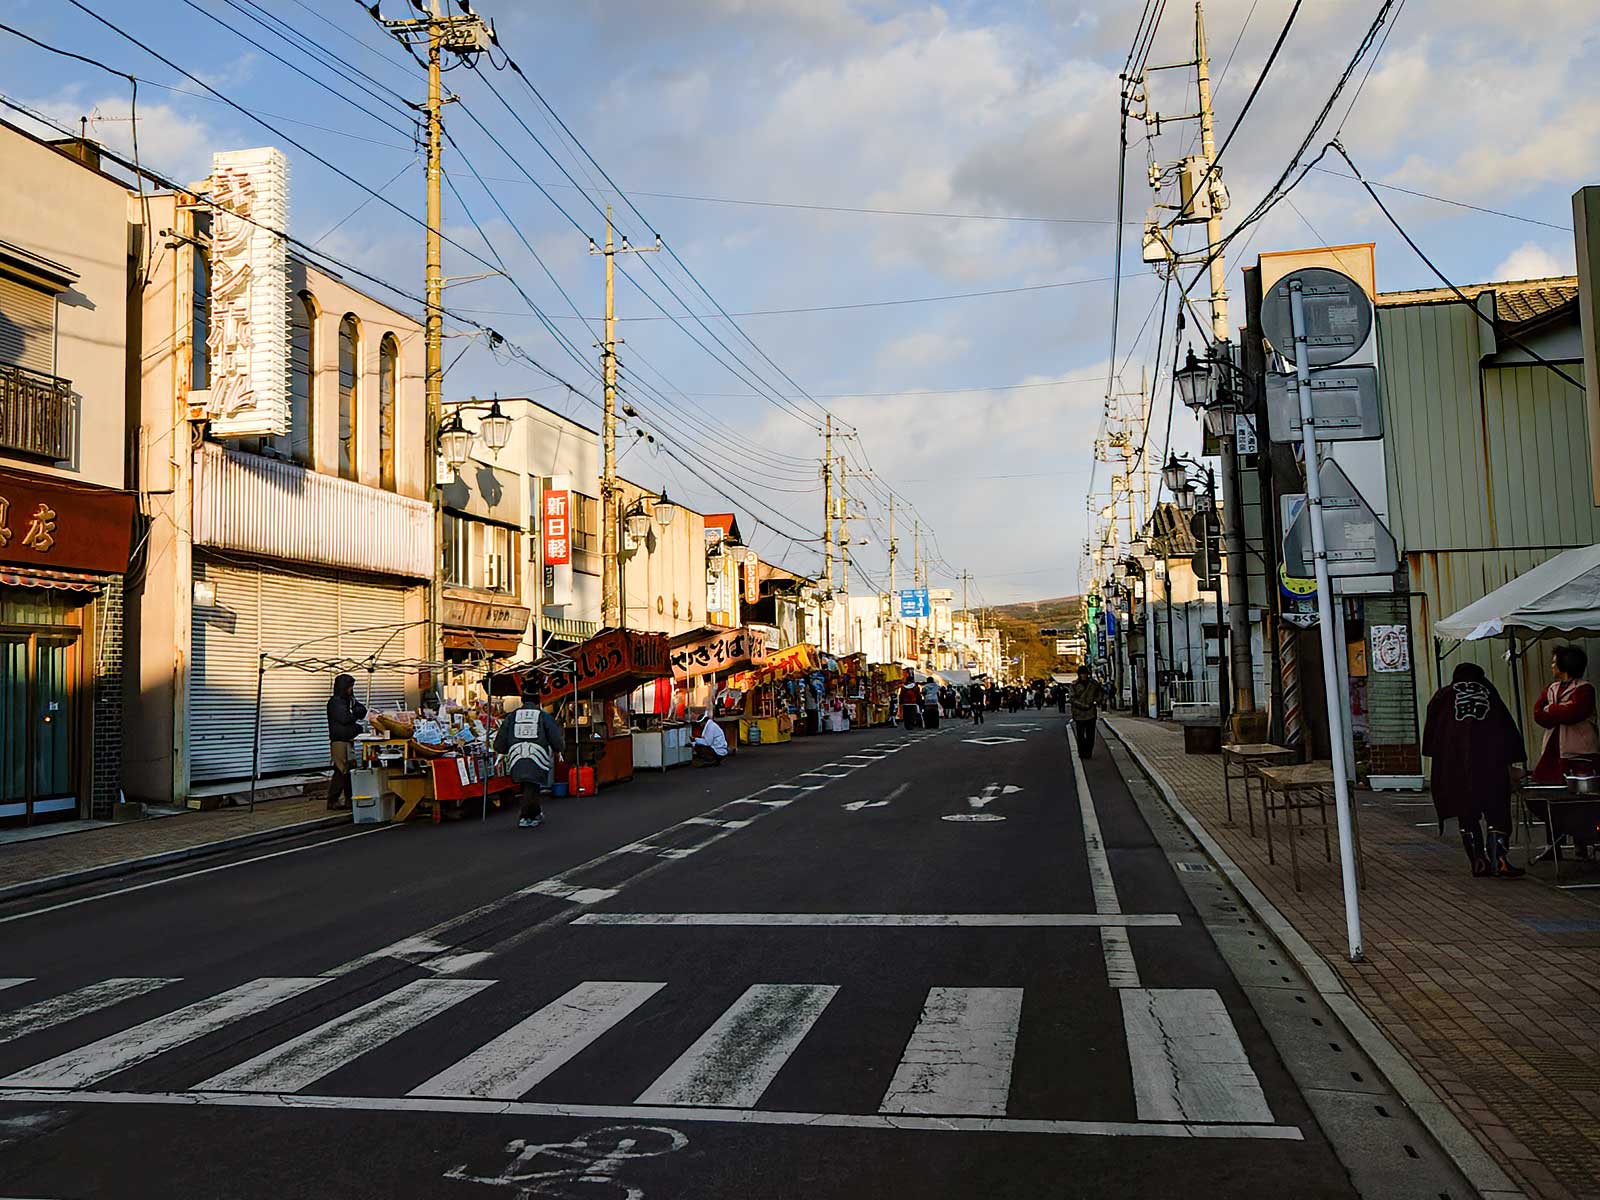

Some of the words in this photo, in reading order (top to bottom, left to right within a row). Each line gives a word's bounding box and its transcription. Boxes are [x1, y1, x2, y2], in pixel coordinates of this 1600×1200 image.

[547, 496, 567, 558] 新日軽
[671, 634, 745, 672] やきそば
